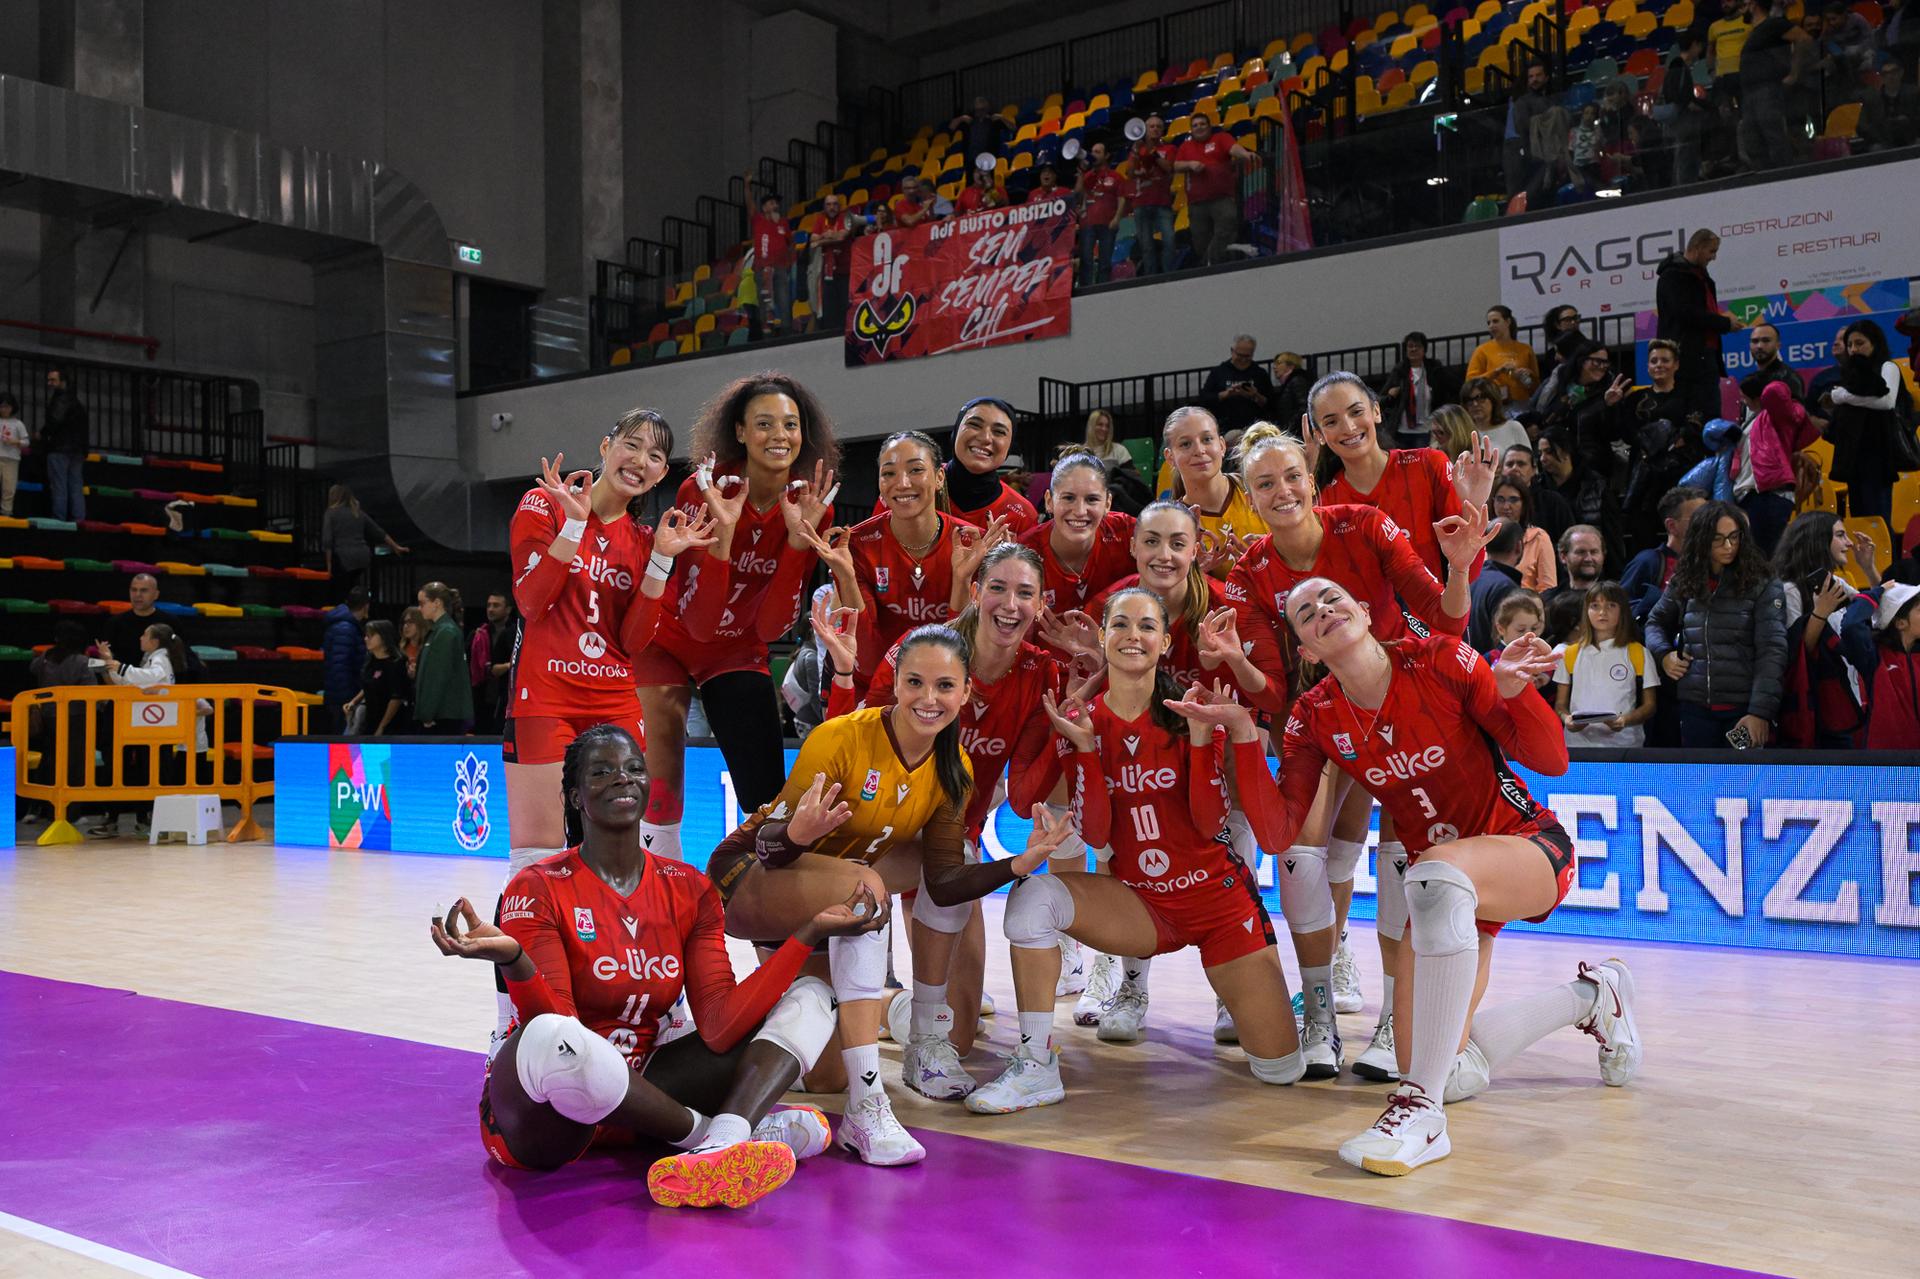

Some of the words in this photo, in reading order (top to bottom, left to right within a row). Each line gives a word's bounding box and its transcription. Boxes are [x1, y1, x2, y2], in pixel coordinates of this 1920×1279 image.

[959, 212, 1004, 236] BUSTO
[1008, 200, 1066, 225] ARSIZIO
[1720, 209, 1834, 238] COSTRUZIONI
[964, 224, 1028, 274] SEM
[1777, 244, 1789, 257] E
[1792, 232, 1881, 256] RESTAURI
[936, 256, 1053, 315] SEMPER
[1788, 341, 1829, 362] EST
[587, 590, 600, 625] 5
[727, 583, 748, 605] 7
[547, 658, 629, 679] motorola
[1411, 787, 1438, 820] 3
[865, 825, 895, 854] 2
[1130, 804, 1161, 843] 10
[616, 993, 651, 1026] 11
